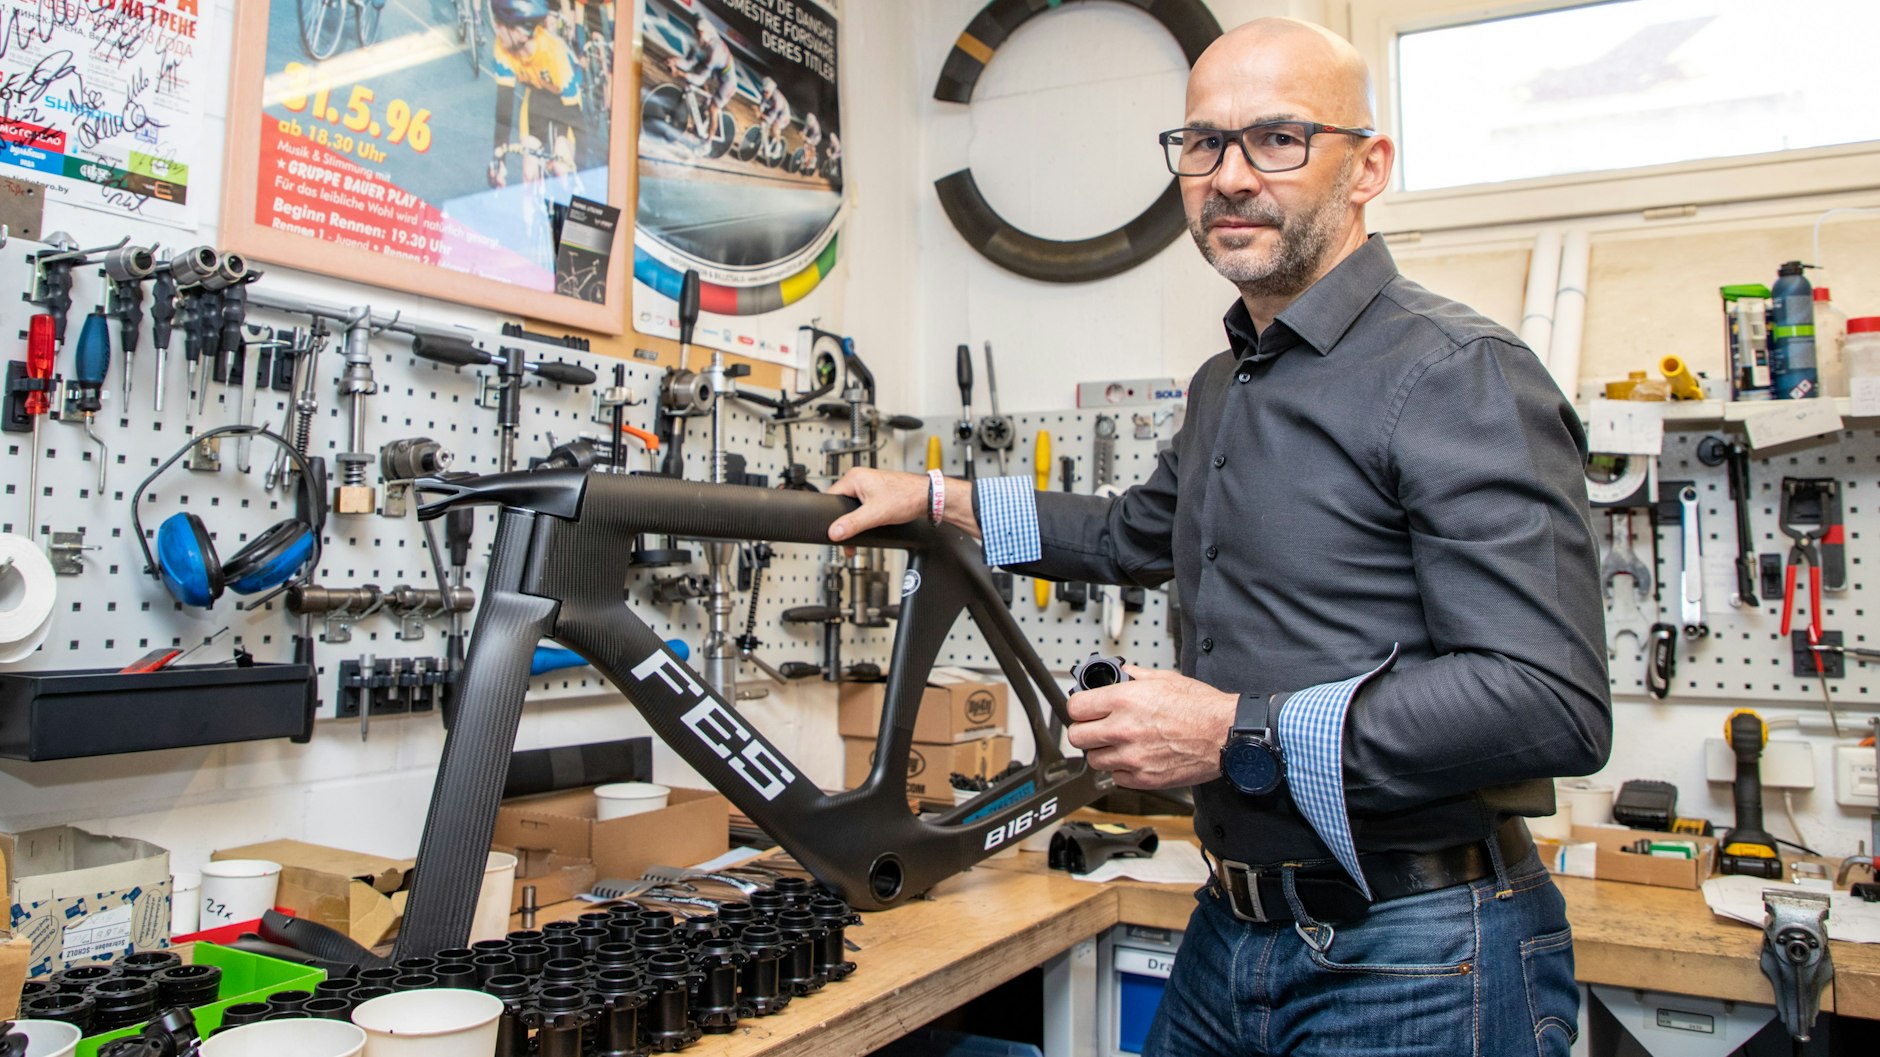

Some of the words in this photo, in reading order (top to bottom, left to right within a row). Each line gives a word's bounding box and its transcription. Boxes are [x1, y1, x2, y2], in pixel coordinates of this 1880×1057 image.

[777, 0, 795, 20] DE
[158, 34, 193, 58] ГОДА
[761, 28, 803, 64] DERES
[803, 48, 835, 84] TITLER
[277, 118, 302, 138] ab
[309, 124, 354, 154] 18.30
[357, 141, 389, 164] Uhr
[277, 139, 310, 159] Musik
[312, 149, 321, 162] &
[322, 152, 374, 181] Stimmung
[375, 170, 392, 183] mit
[275, 174, 294, 191] Für
[297, 182, 318, 198] das
[320, 187, 366, 211] leibliche
[367, 200, 395, 219] Wohl
[396, 211, 419, 226] wird
[288, 159, 342, 188] GRUPPE
[343, 175, 386, 202] BAUER
[387, 188, 418, 209] PLAY
[273, 197, 327, 224] Beginn
[329, 211, 387, 240] Rennen:
[391, 228, 427, 249] 19.30
[429, 238, 453, 256] Uhr
[630, 648, 796, 801] FES
[66, 946, 91, 958] SCHOLZ
[94, 939, 126, 950] Schrauben
